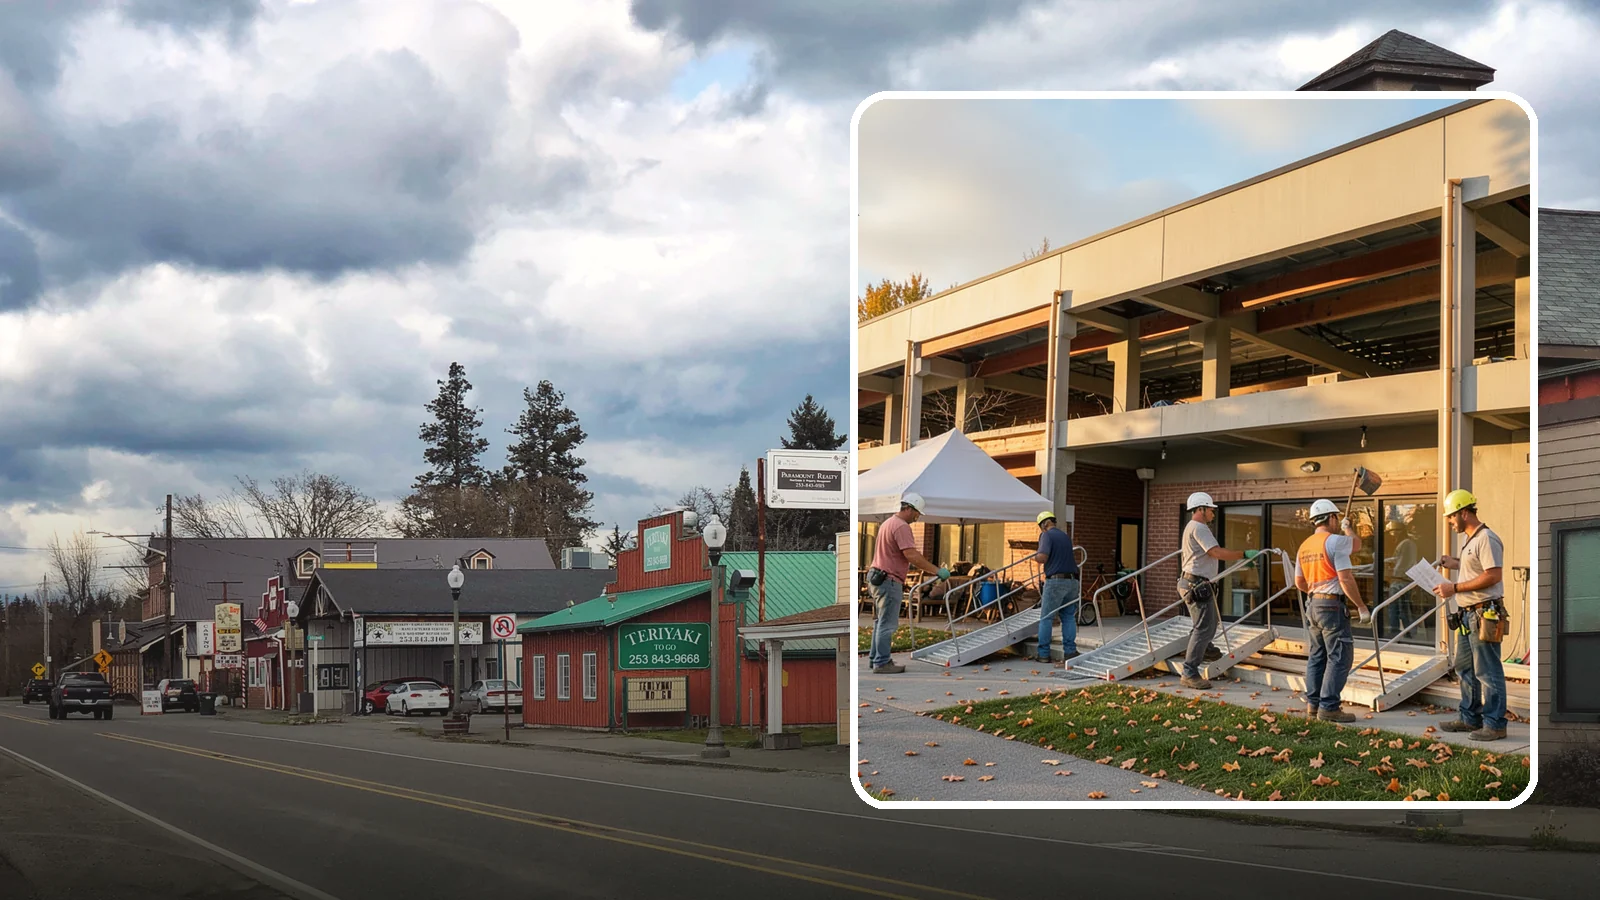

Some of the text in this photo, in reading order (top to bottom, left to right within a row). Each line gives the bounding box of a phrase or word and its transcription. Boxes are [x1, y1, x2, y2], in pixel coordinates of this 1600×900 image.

[817, 472, 839, 480] REALTY
[624, 627, 703, 646] TERIYAKI
[653, 643, 677, 651] TO GO
[628, 653, 700, 665] 253 843-9668
